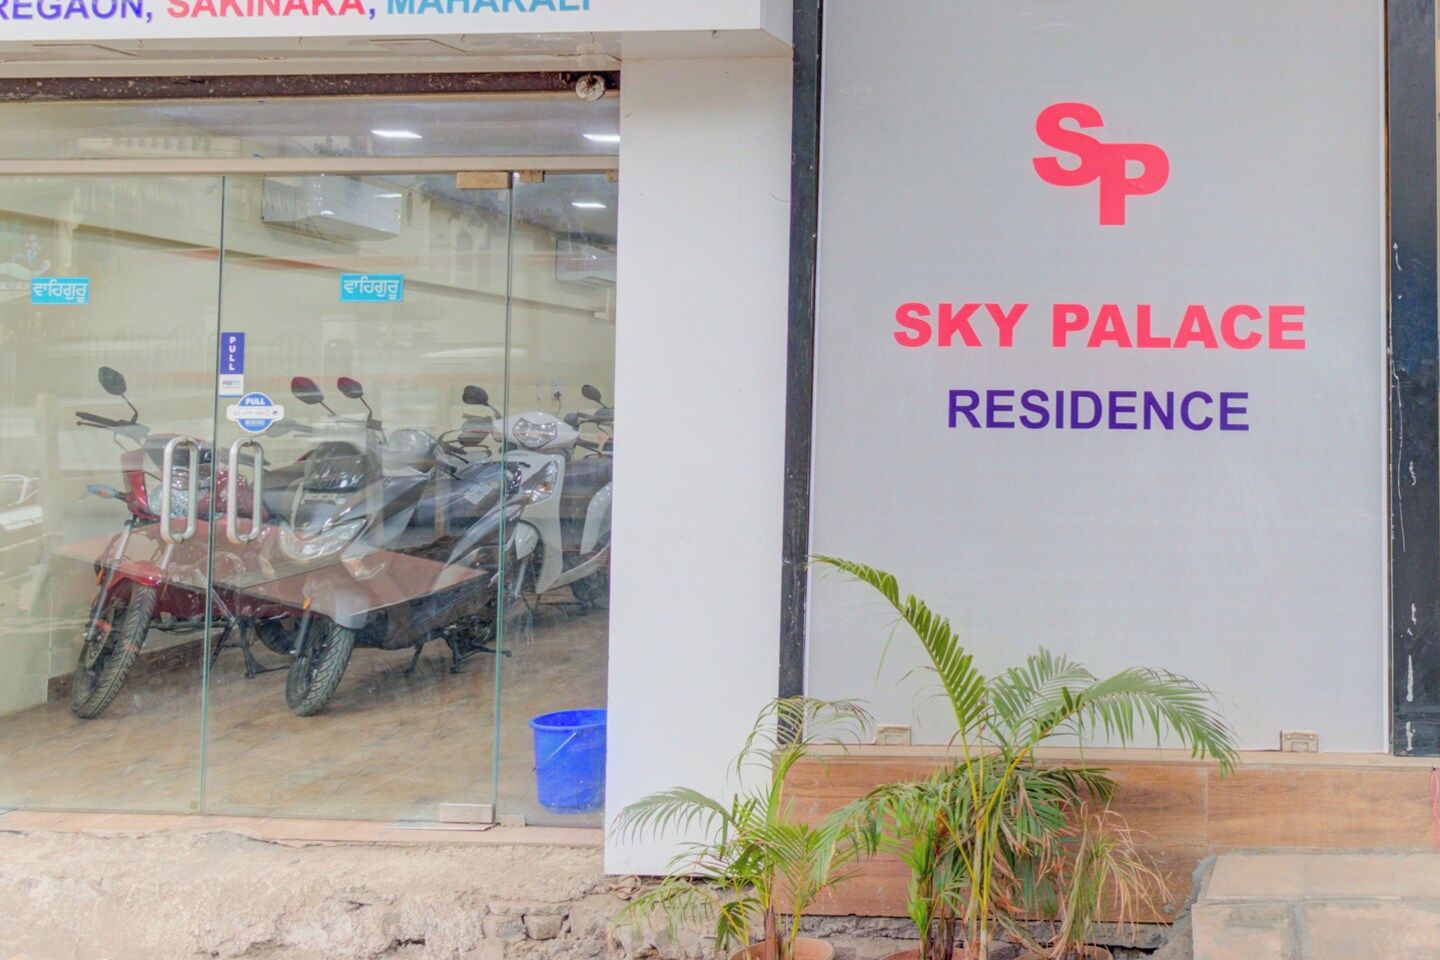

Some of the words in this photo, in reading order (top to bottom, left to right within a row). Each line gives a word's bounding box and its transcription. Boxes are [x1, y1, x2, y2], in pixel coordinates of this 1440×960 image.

[1033, 102, 1170, 226] SP
[893, 302, 1029, 348] SKY
[1052, 304, 1307, 350] PALACE
[228, 336, 237, 371] PULL
[245, 397, 266, 405] PULL
[948, 389, 1250, 432] RESIDENCE
